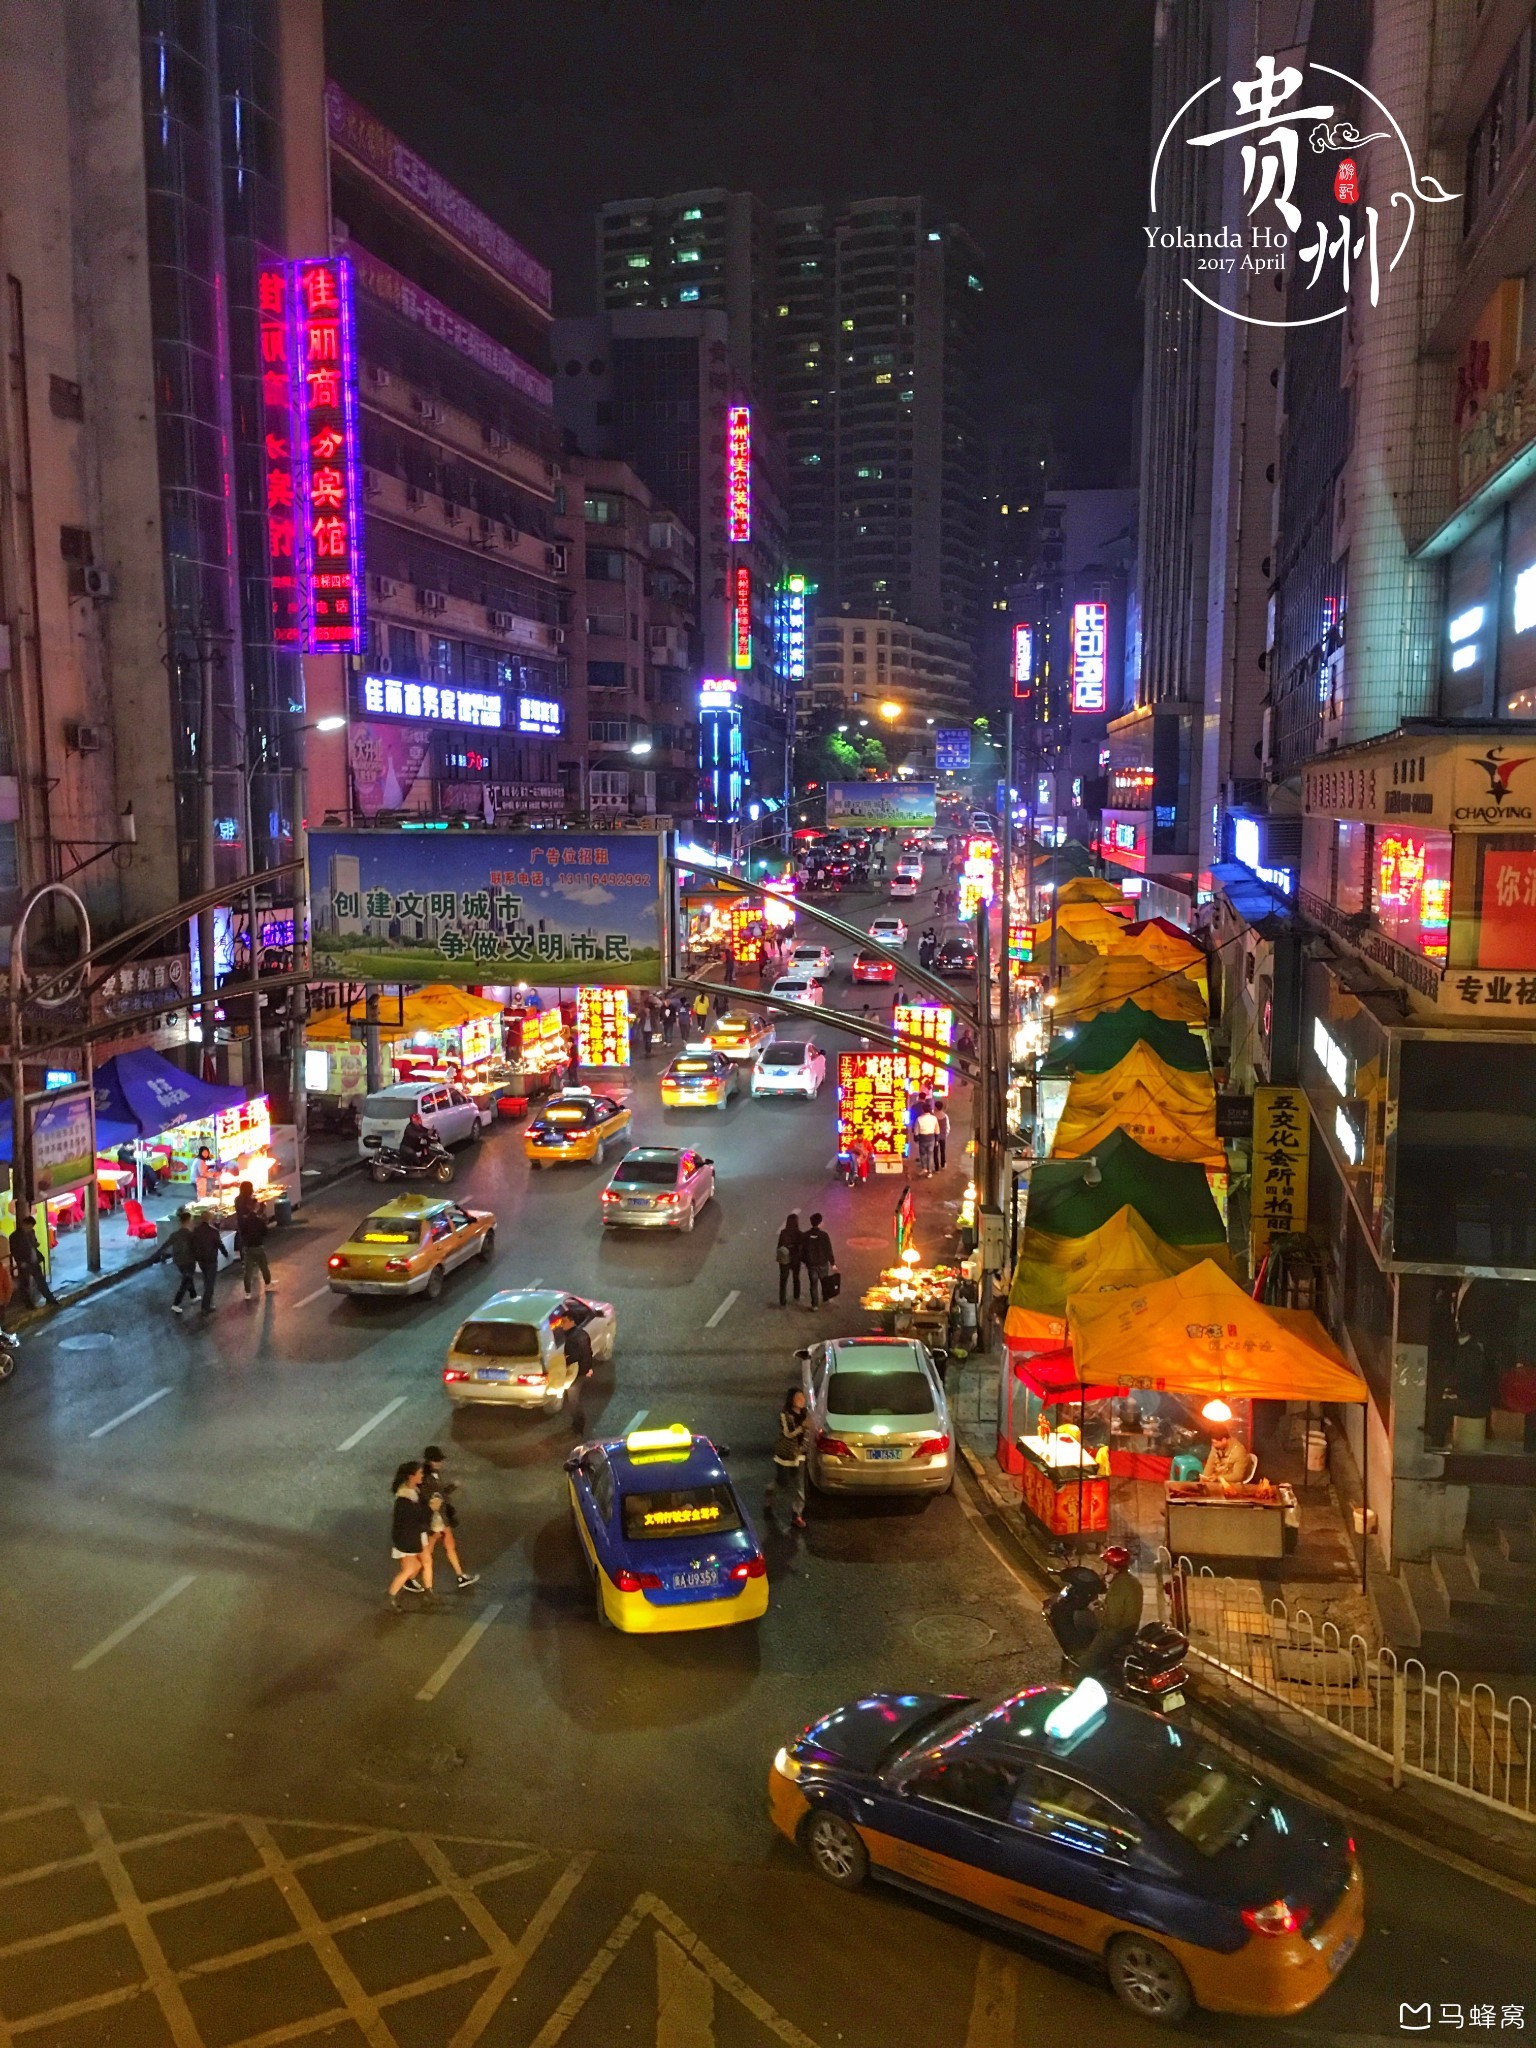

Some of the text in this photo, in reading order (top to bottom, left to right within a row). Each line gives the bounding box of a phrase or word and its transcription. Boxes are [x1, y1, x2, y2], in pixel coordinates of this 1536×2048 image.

[1455, 807, 1532, 824] CHAOYING
[530, 848, 610, 866] 广告位招租
[559, 873, 650, 887] 13116492992
[333, 892, 523, 922] 创建文明城市
[439, 932, 633, 963] 争做文明市民
[1264, 1096, 1300, 1186] 五交化会所
[1263, 1196, 1294, 1245] 柏丽
